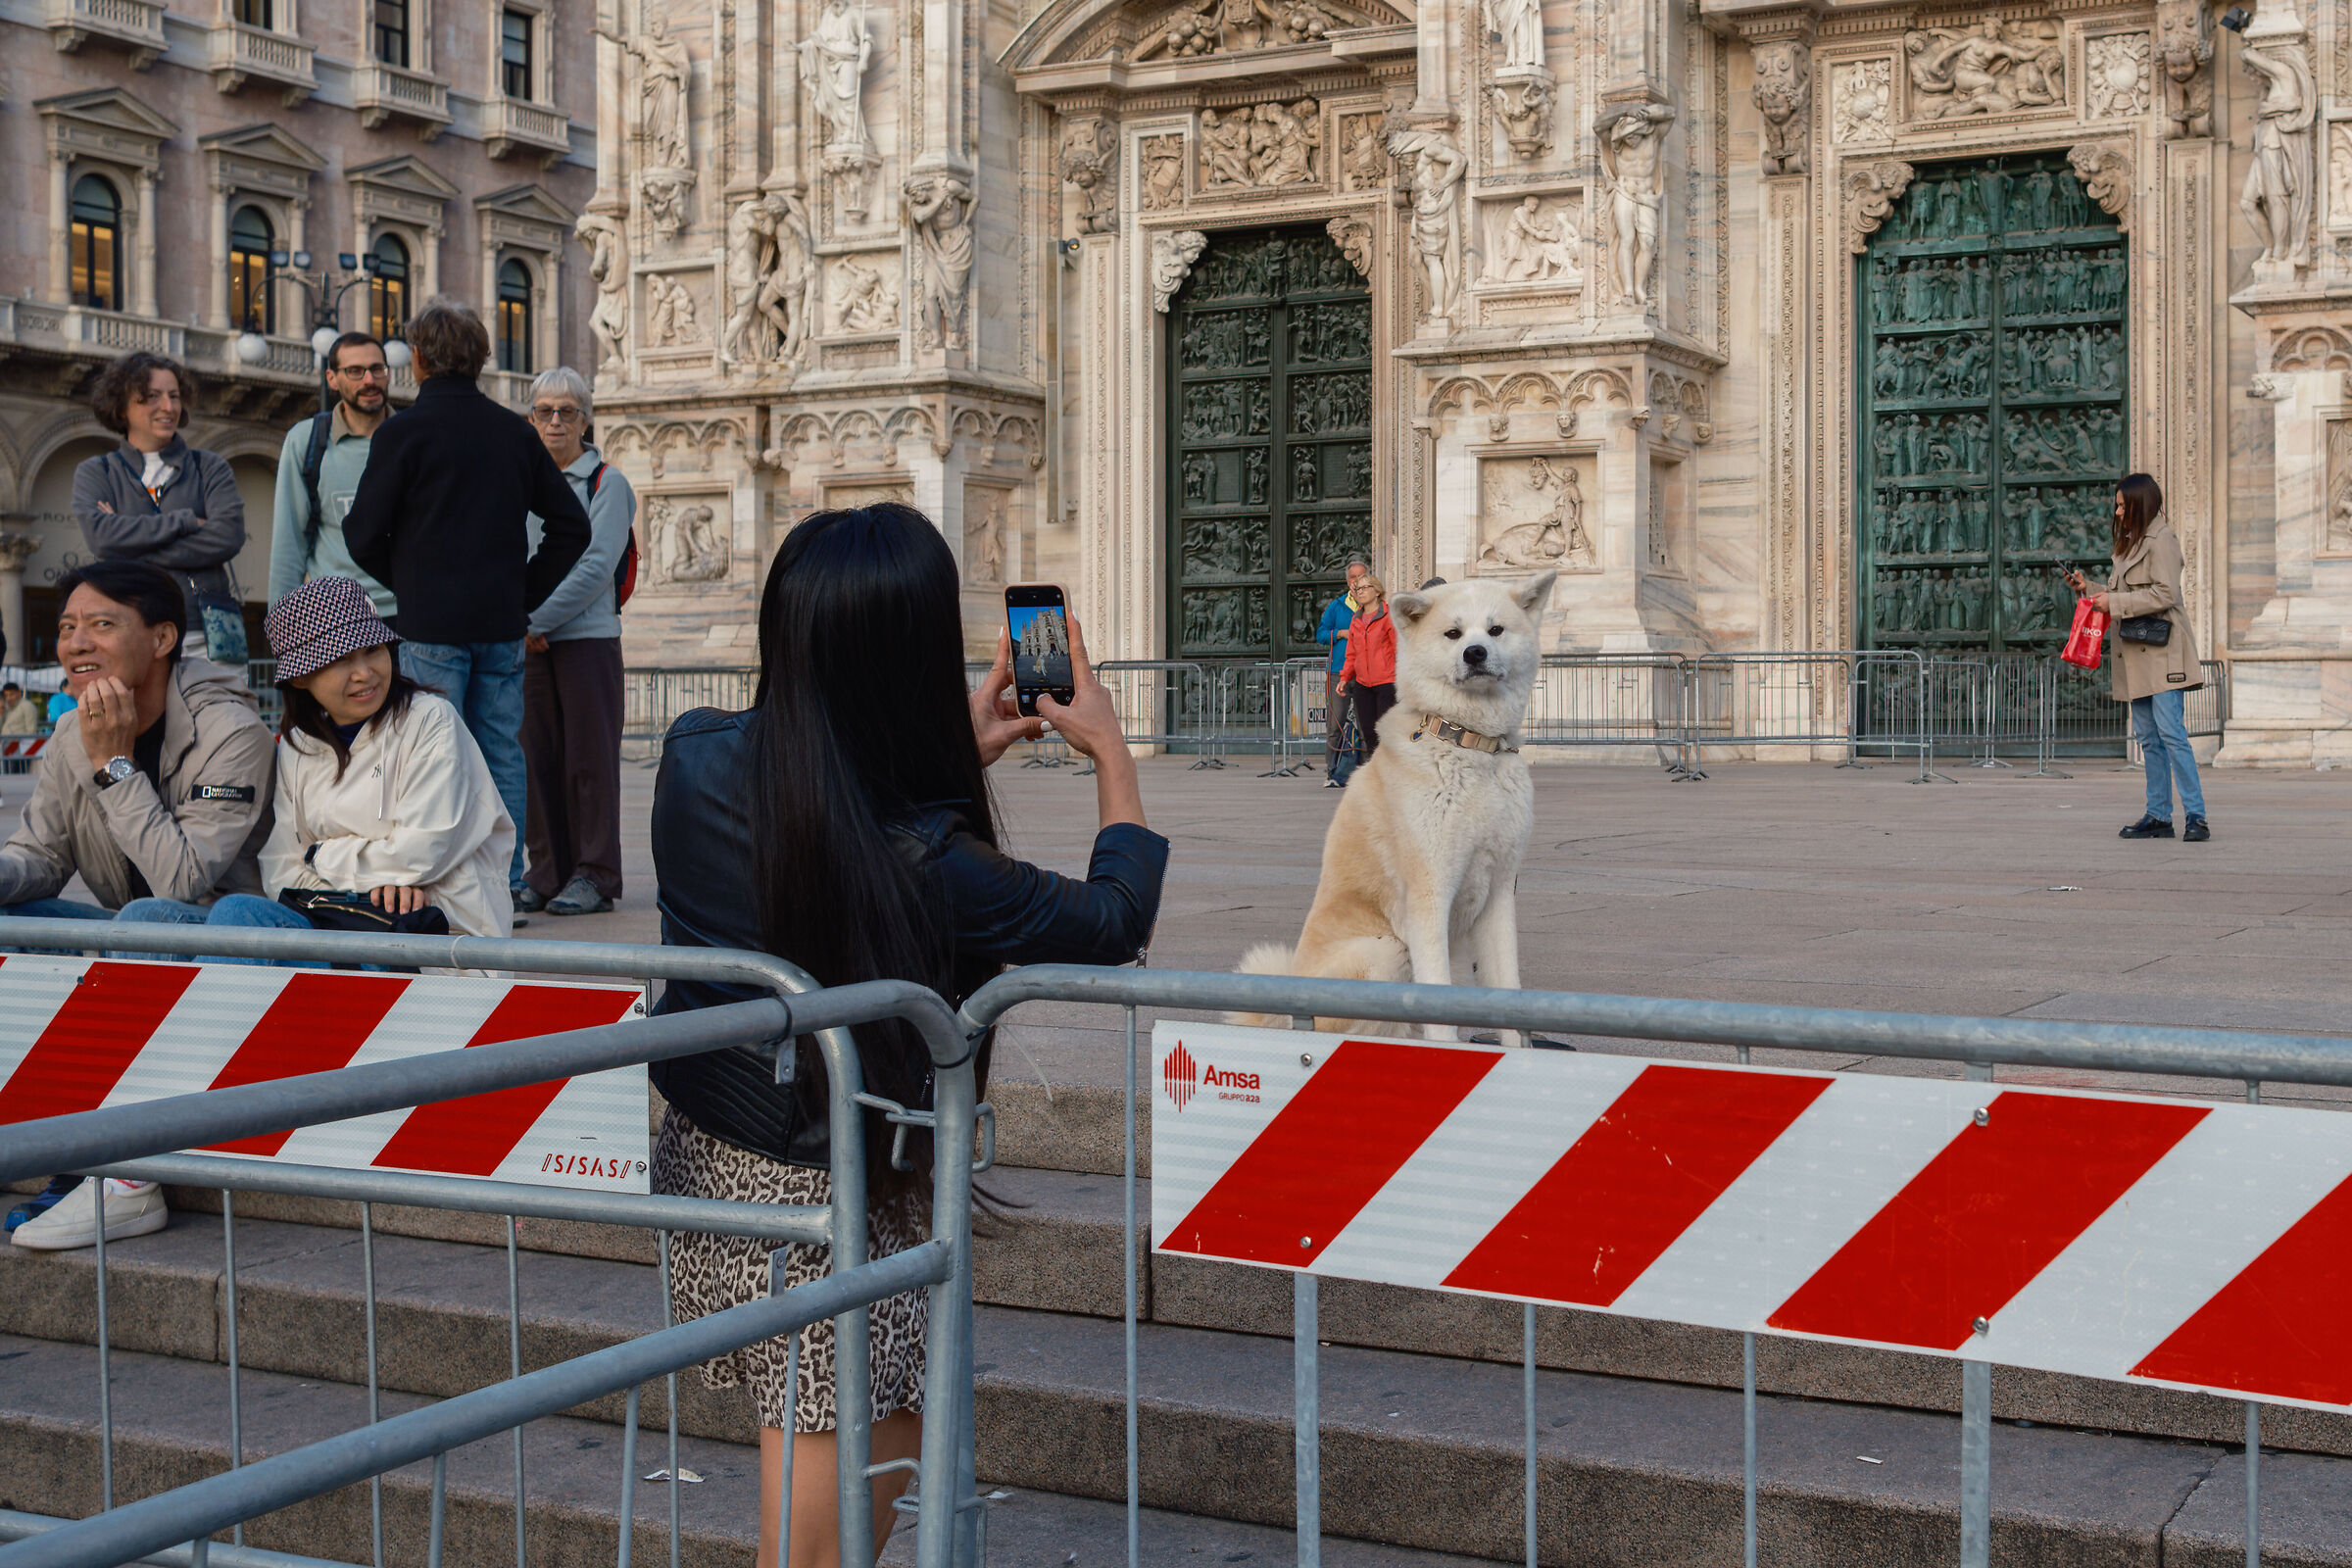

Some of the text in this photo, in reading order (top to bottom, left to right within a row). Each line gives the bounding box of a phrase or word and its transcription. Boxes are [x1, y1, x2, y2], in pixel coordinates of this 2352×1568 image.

[1308, 708, 1327, 722] ONL
[1203, 1064, 1260, 1090] Amsa
[1218, 1092, 1246, 1102] GRUPPO
